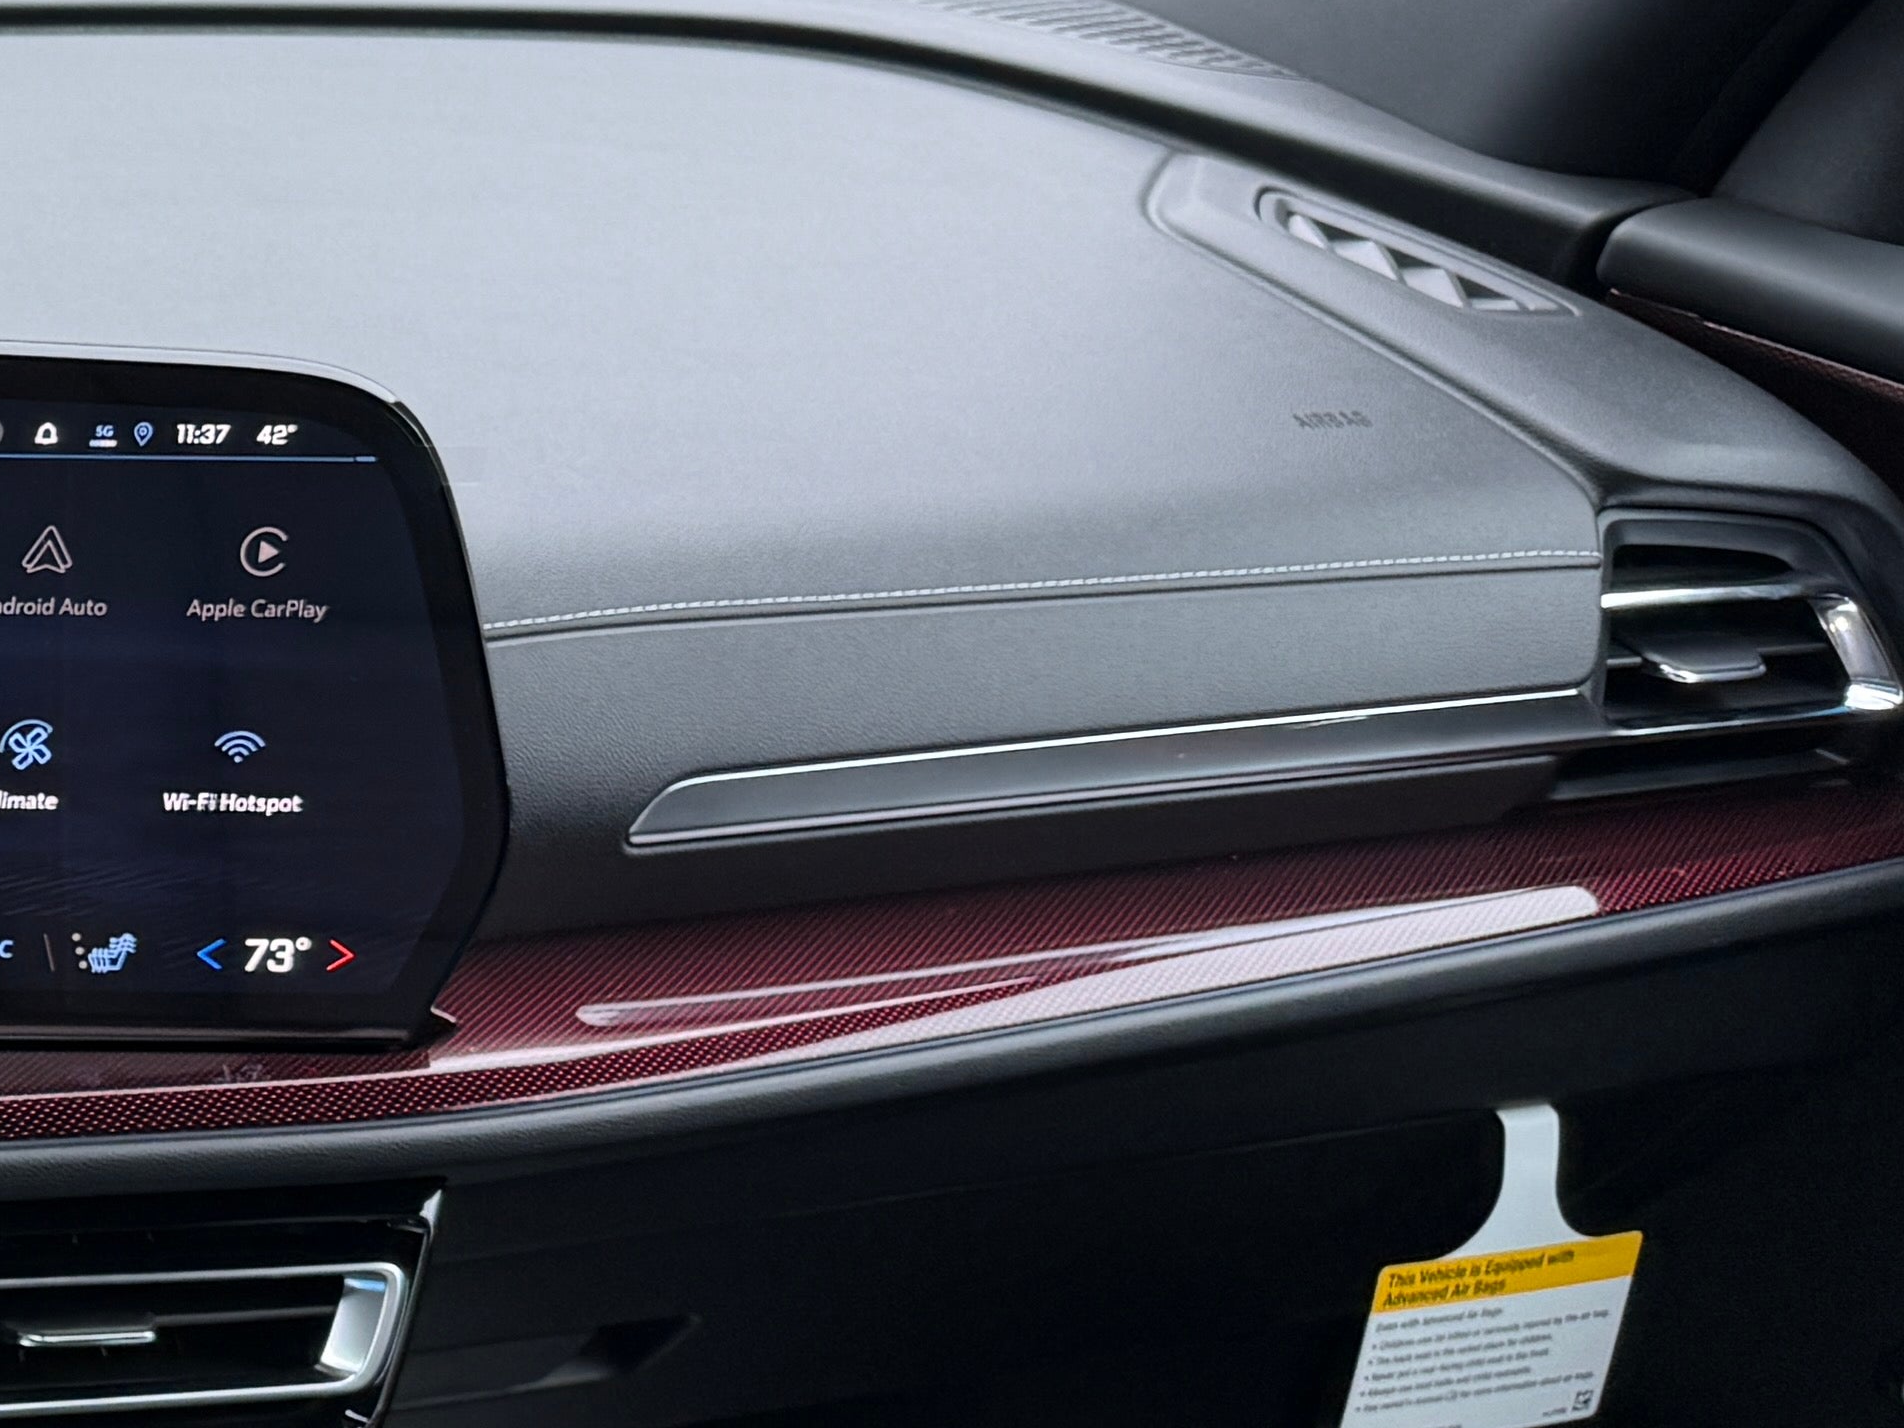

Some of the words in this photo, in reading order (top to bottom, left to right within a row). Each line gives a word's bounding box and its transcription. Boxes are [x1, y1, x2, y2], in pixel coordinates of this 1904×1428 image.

[176, 423, 230, 445] 11:37
[59, 597, 107, 618] Auto
[186, 599, 246, 623] Apple
[250, 599, 328, 623] CarPlay
[163, 791, 216, 813] Wi-Fi
[219, 792, 303, 815] Hotspot
